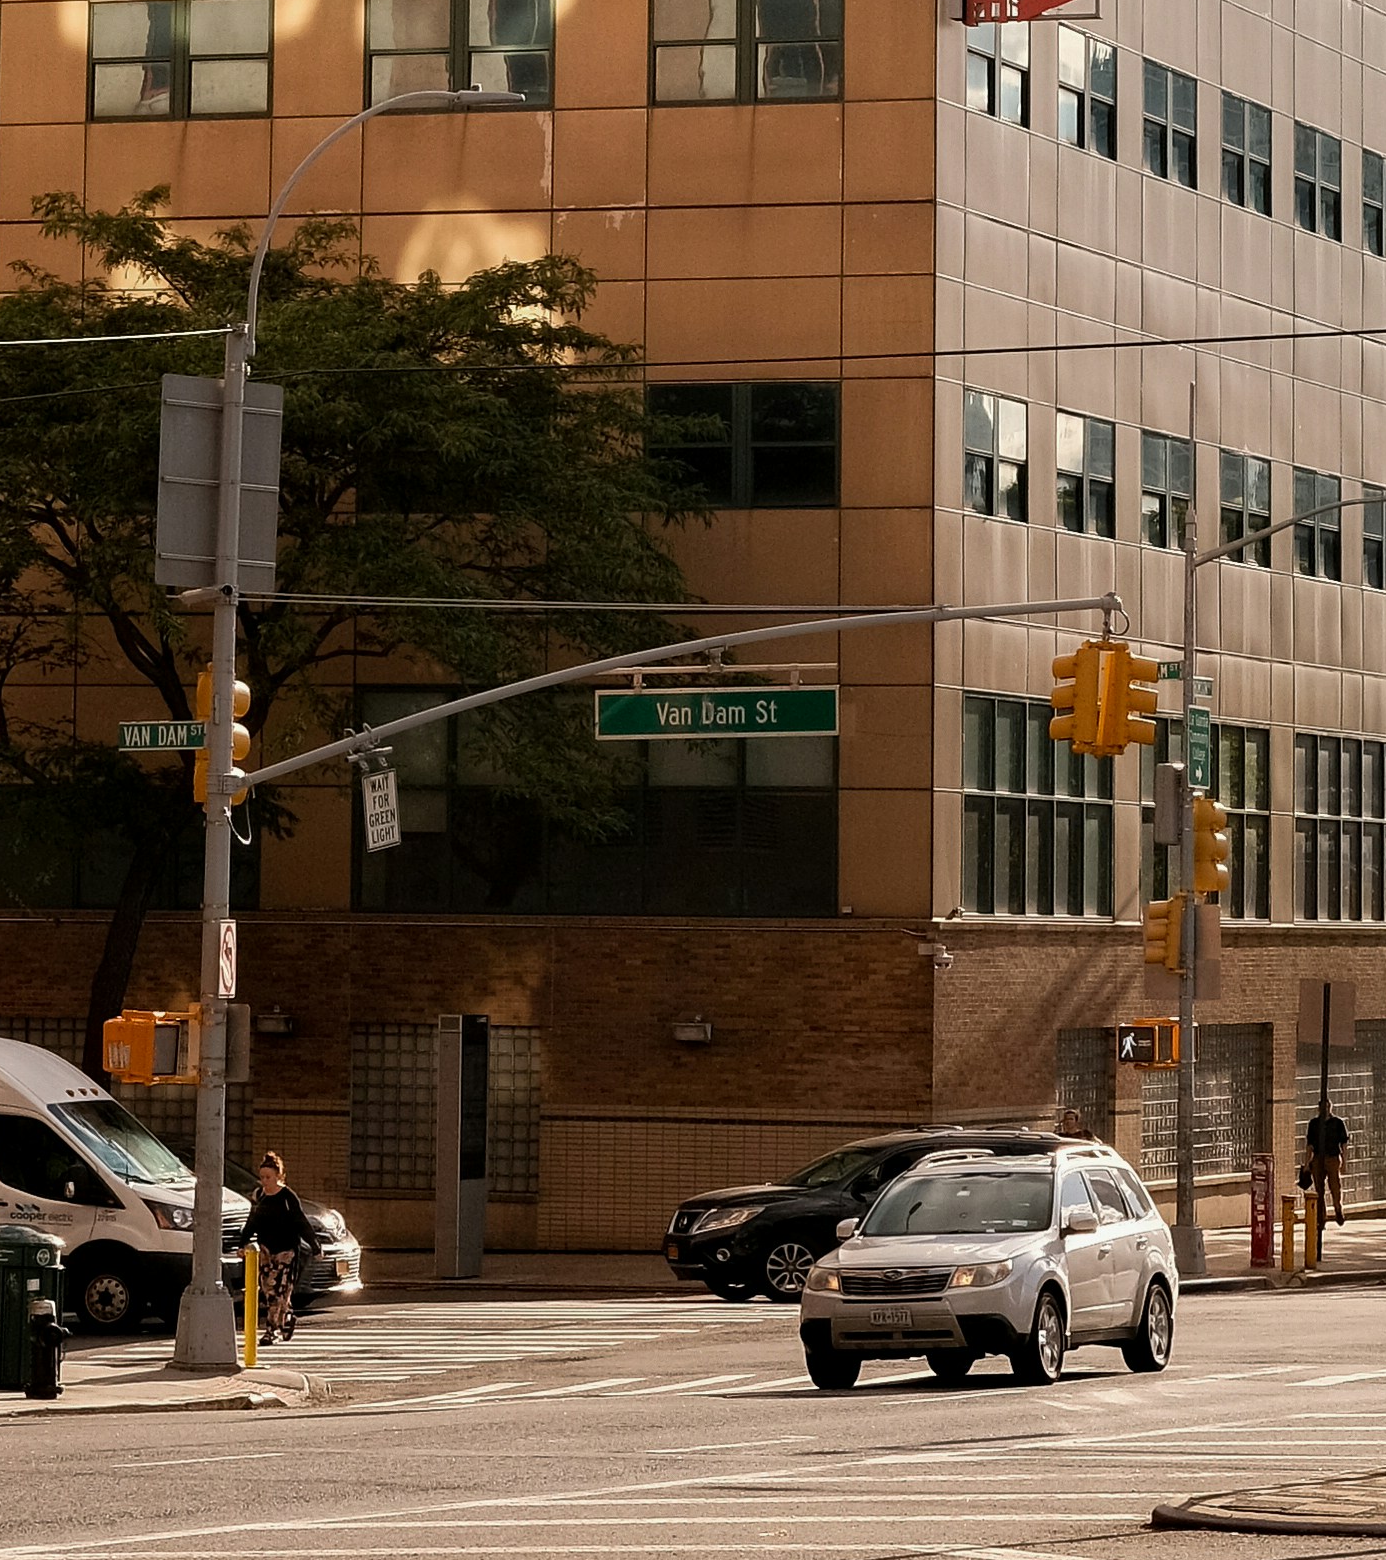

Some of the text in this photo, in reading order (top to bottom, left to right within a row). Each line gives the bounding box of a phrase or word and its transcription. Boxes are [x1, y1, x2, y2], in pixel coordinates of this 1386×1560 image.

[656, 699, 778, 725] Van Dam St
[123, 724, 203, 747] VAN DAM ST
[371, 776, 389, 793] WAIT
[373, 793, 390, 810] FOR
[369, 808, 396, 828] GREEN
[371, 825, 395, 844] LIGHT
[10, 1210, 47, 1221] cooper
